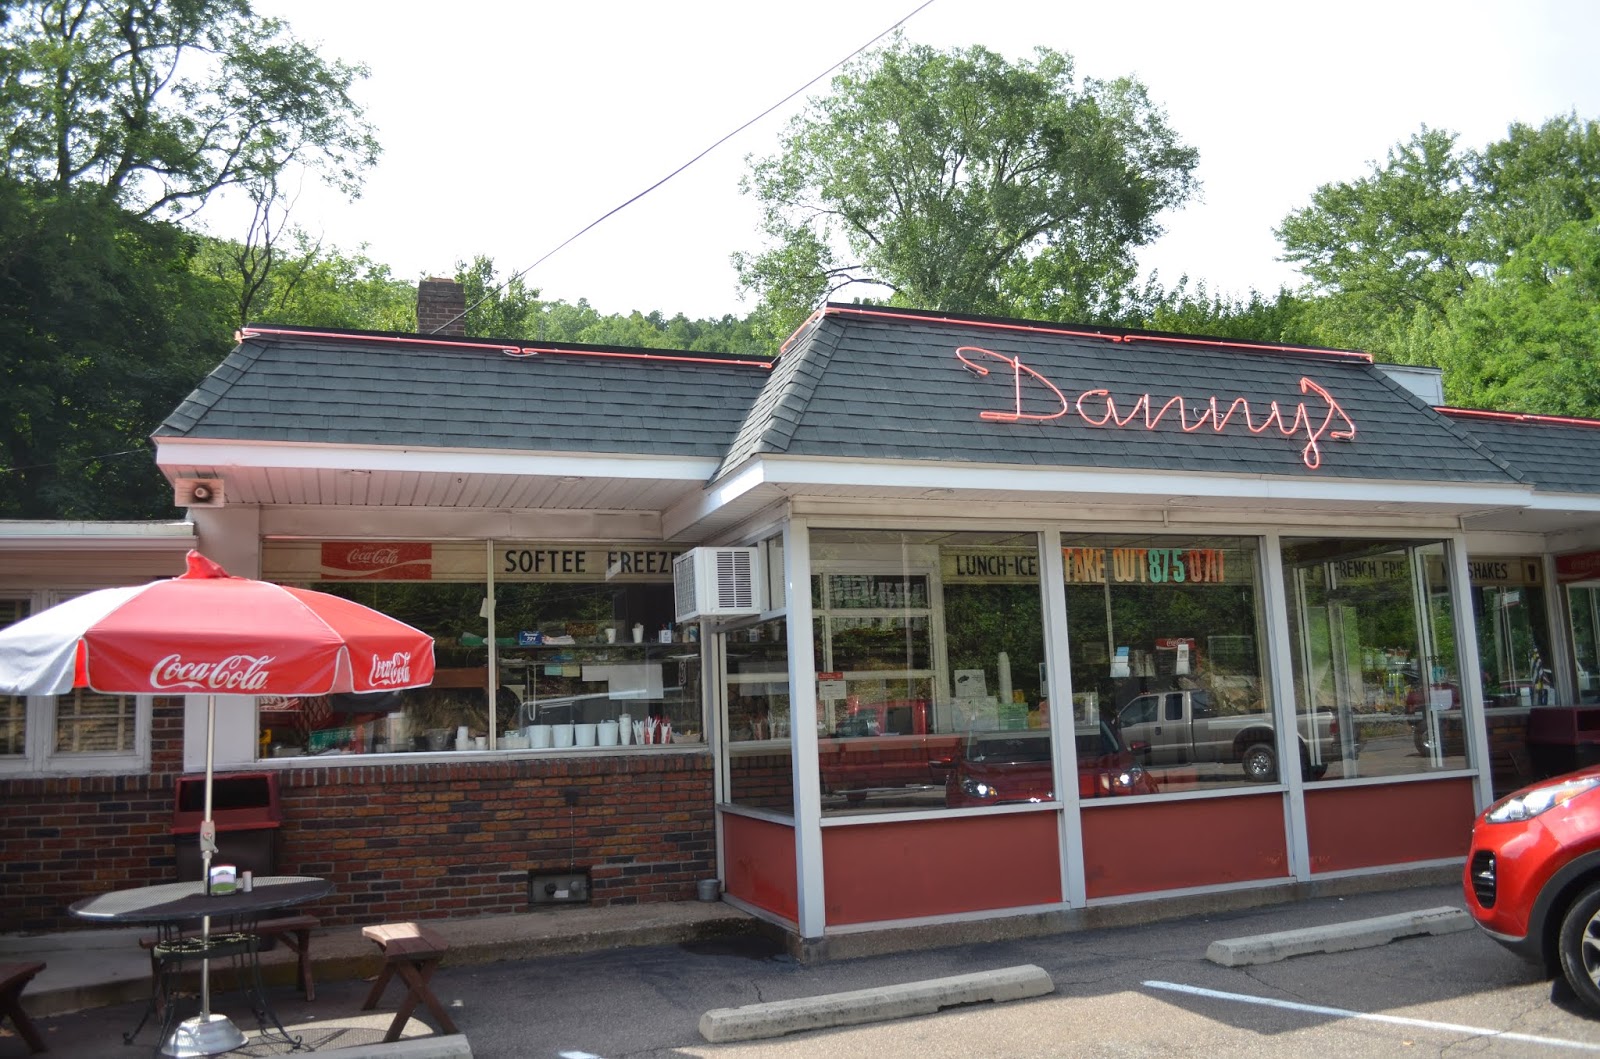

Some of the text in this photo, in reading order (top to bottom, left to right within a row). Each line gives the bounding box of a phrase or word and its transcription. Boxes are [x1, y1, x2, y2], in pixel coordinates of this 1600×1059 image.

[346, 548, 400, 565] Coca-Cola
[505, 549, 586, 573] SOFTEE
[956, 555, 1037, 576] LUNCH-ICE
[1062, 549, 1106, 583] TAKE
[1113, 549, 1147, 583] OUT
[1148, 549, 1186, 583] 875
[150, 653, 276, 690] Coca-Cola
[369, 651, 411, 687] Coca-Cola
